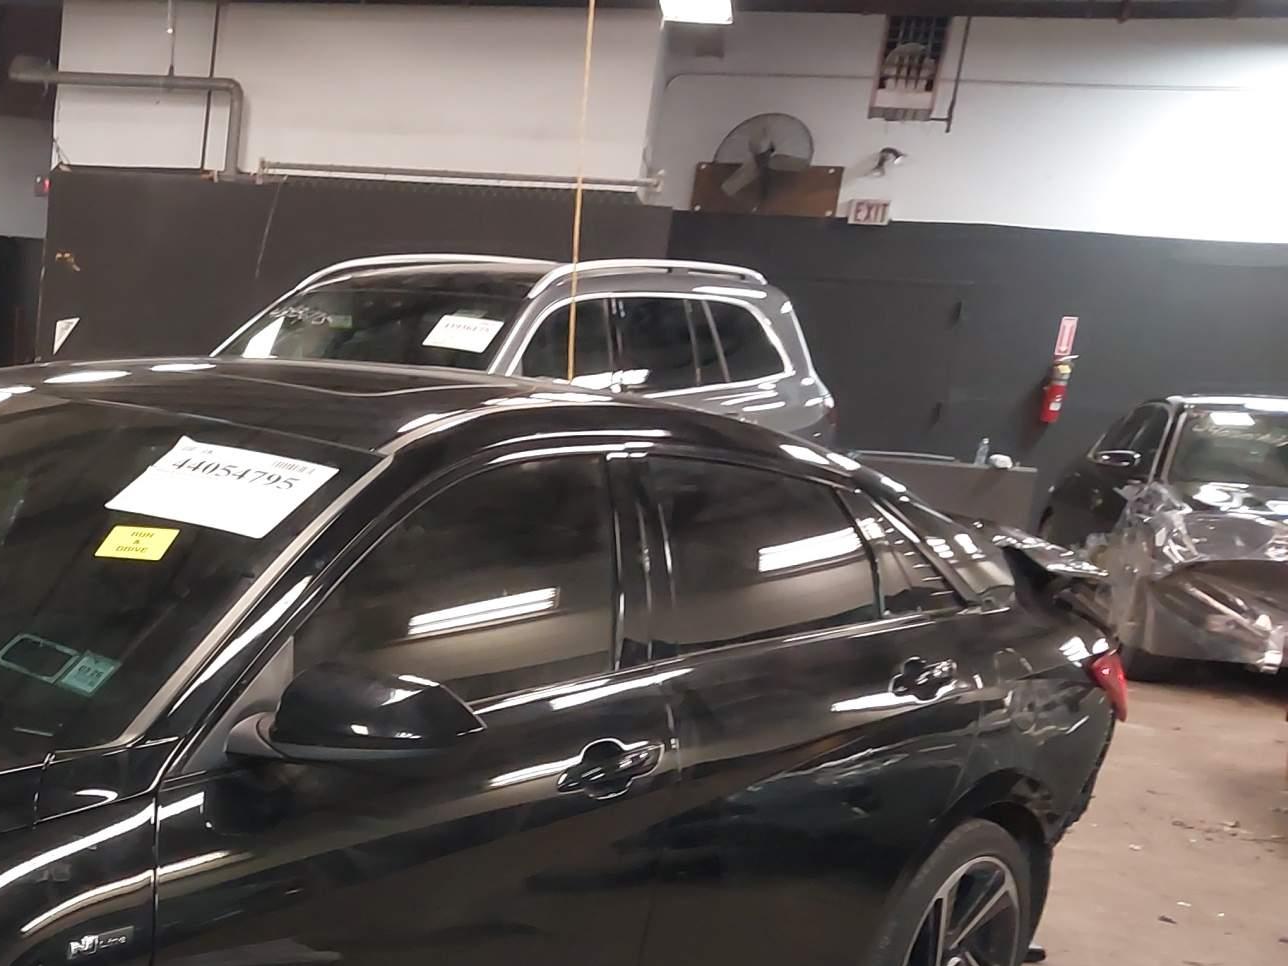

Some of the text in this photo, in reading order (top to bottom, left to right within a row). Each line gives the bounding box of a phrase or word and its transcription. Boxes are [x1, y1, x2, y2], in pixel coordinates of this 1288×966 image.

[854, 201, 889, 223] EXIT
[172, 457, 300, 490] 44054795
[115, 545, 148, 553] DRIVE
